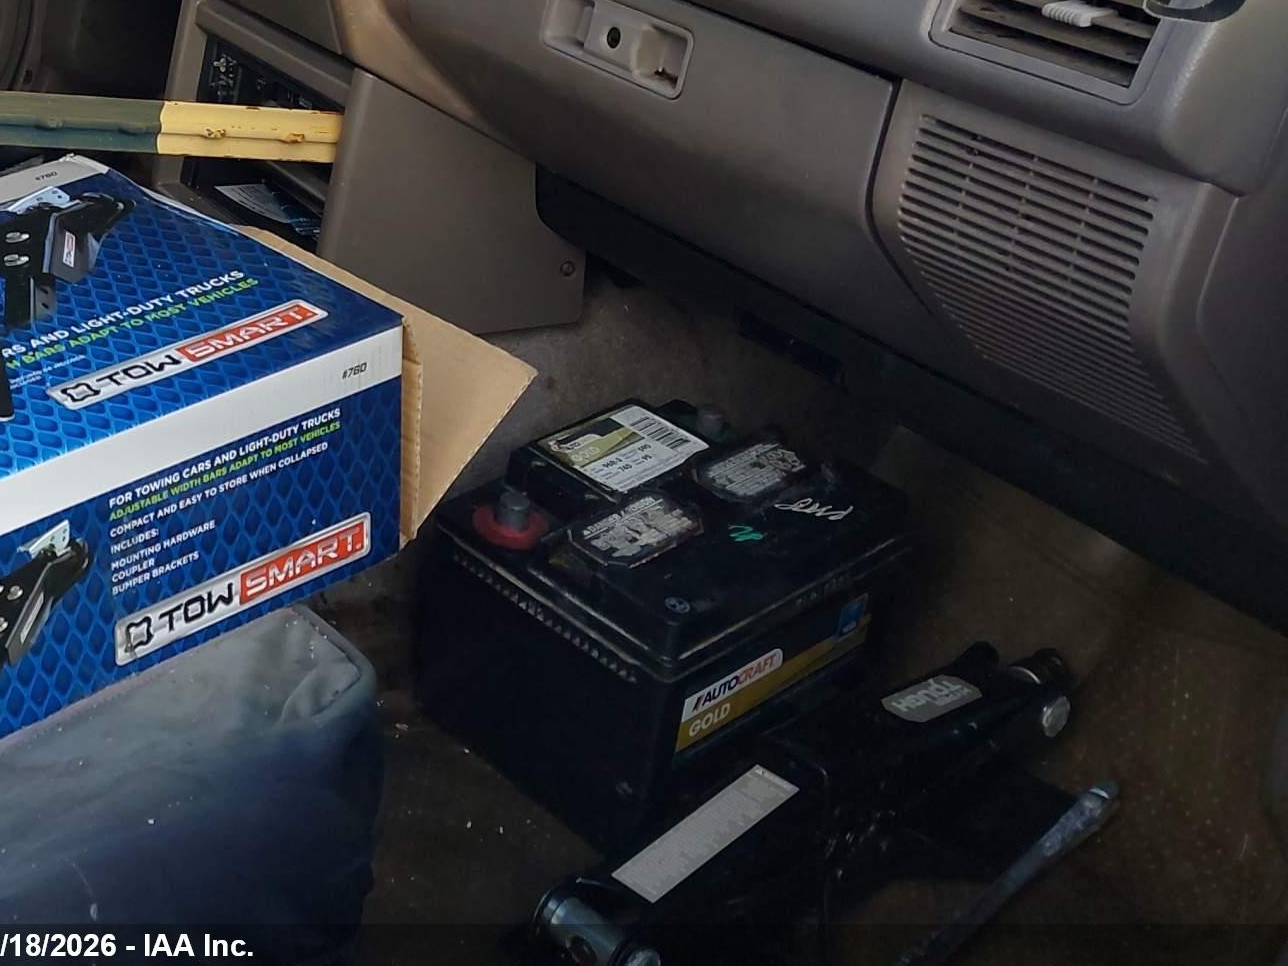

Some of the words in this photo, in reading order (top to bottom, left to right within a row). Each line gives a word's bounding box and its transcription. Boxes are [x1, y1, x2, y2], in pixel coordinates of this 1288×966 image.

[1, 344, 26, 359] RS
[30, 328, 70, 348] AND
[71, 293, 174, 335] LIGHT-DUTY
[176, 270, 245, 300] TRUCKS
[22, 343, 67, 366] BARS
[68, 326, 120, 348] ADAPT
[120, 316, 145, 332] TO
[145, 302, 188, 323] MOST
[187, 277, 260, 308] VEHICLES
[96, 354, 182, 388] TOW
[342, 362, 368, 380] #760
[108, 491, 132, 509] FOR
[134, 472, 181, 498] TOWING
[182, 459, 212, 480] CARS
[214, 450, 238, 468] AND
[239, 424, 300, 457] LIGHT-DUTY
[300, 408, 341, 431] TRUCKS
[109, 492, 169, 522] ADJUSTABLE
[170, 478, 202, 497] WIDTH
[202, 466, 228, 484] BARS
[228, 454, 259, 474] ADAPT
[260, 448, 272, 460] TO
[273, 437, 299, 456] MOST
[299, 421, 341, 444] VEHICLES
[110, 513, 156, 538] COMPACT
[156, 503, 178, 520] AND
[179, 492, 203, 511] EASY
[204, 486, 218, 499] TO
[219, 474, 248, 494] STORE
[249, 462, 277, 481] WHEN
[278, 441, 329, 470] COLLAPSED
[110, 528, 160, 555] INCLUDES:
[111, 542, 162, 572] MOUNTING
[163, 520, 216, 550] HARDWARE
[111, 558, 156, 584] COUPLER
[112, 573, 151, 596] BUMPER
[152, 550, 200, 578] BRACKETS
[158, 582, 234, 632] TOW
[701, 653, 778, 707] AUTOCRAFT
[891, 678, 963, 712] TOUGH
[688, 702, 731, 738] GOLD
